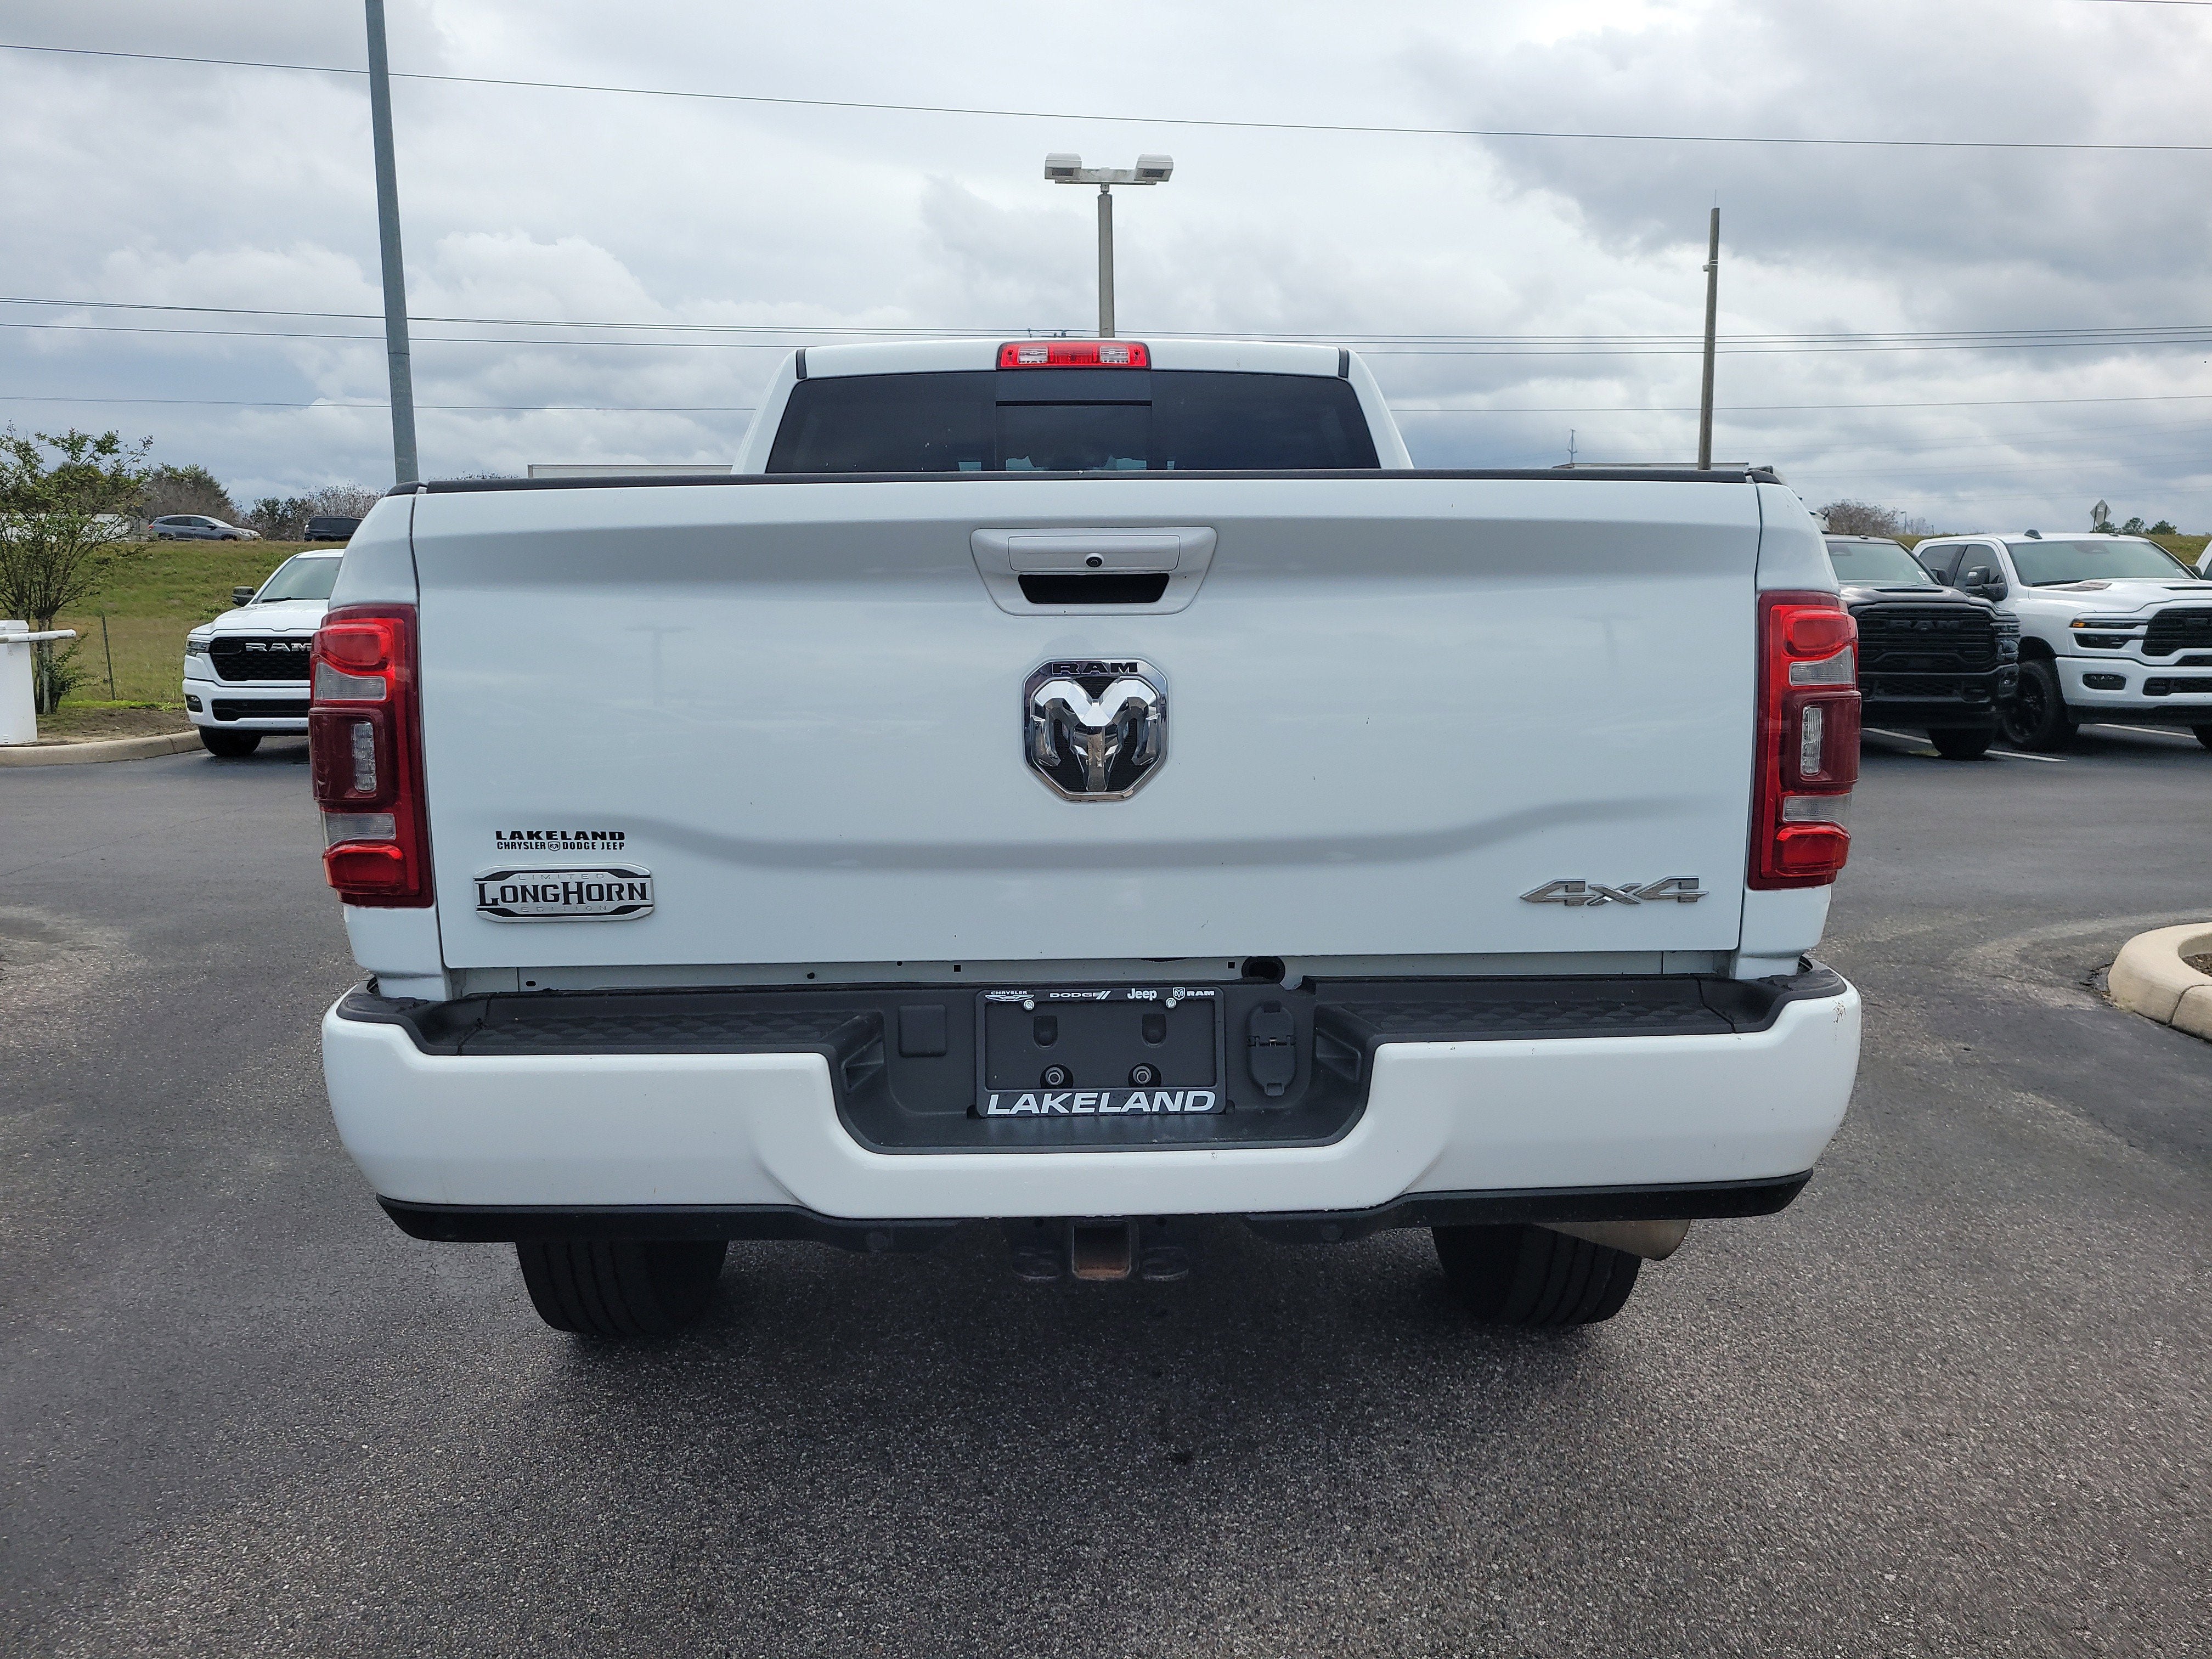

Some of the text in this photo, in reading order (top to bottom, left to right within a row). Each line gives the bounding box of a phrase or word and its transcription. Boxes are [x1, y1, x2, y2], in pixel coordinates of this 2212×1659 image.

[245, 642, 312, 652] RAM
[1052, 662, 1138, 675] RAM
[495, 830, 625, 840] LAKELAND
[496, 842, 546, 850] CHRYSLER
[1127, 988, 1157, 1001] Jeep
[988, 1091, 1216, 1115] LAKELAND
